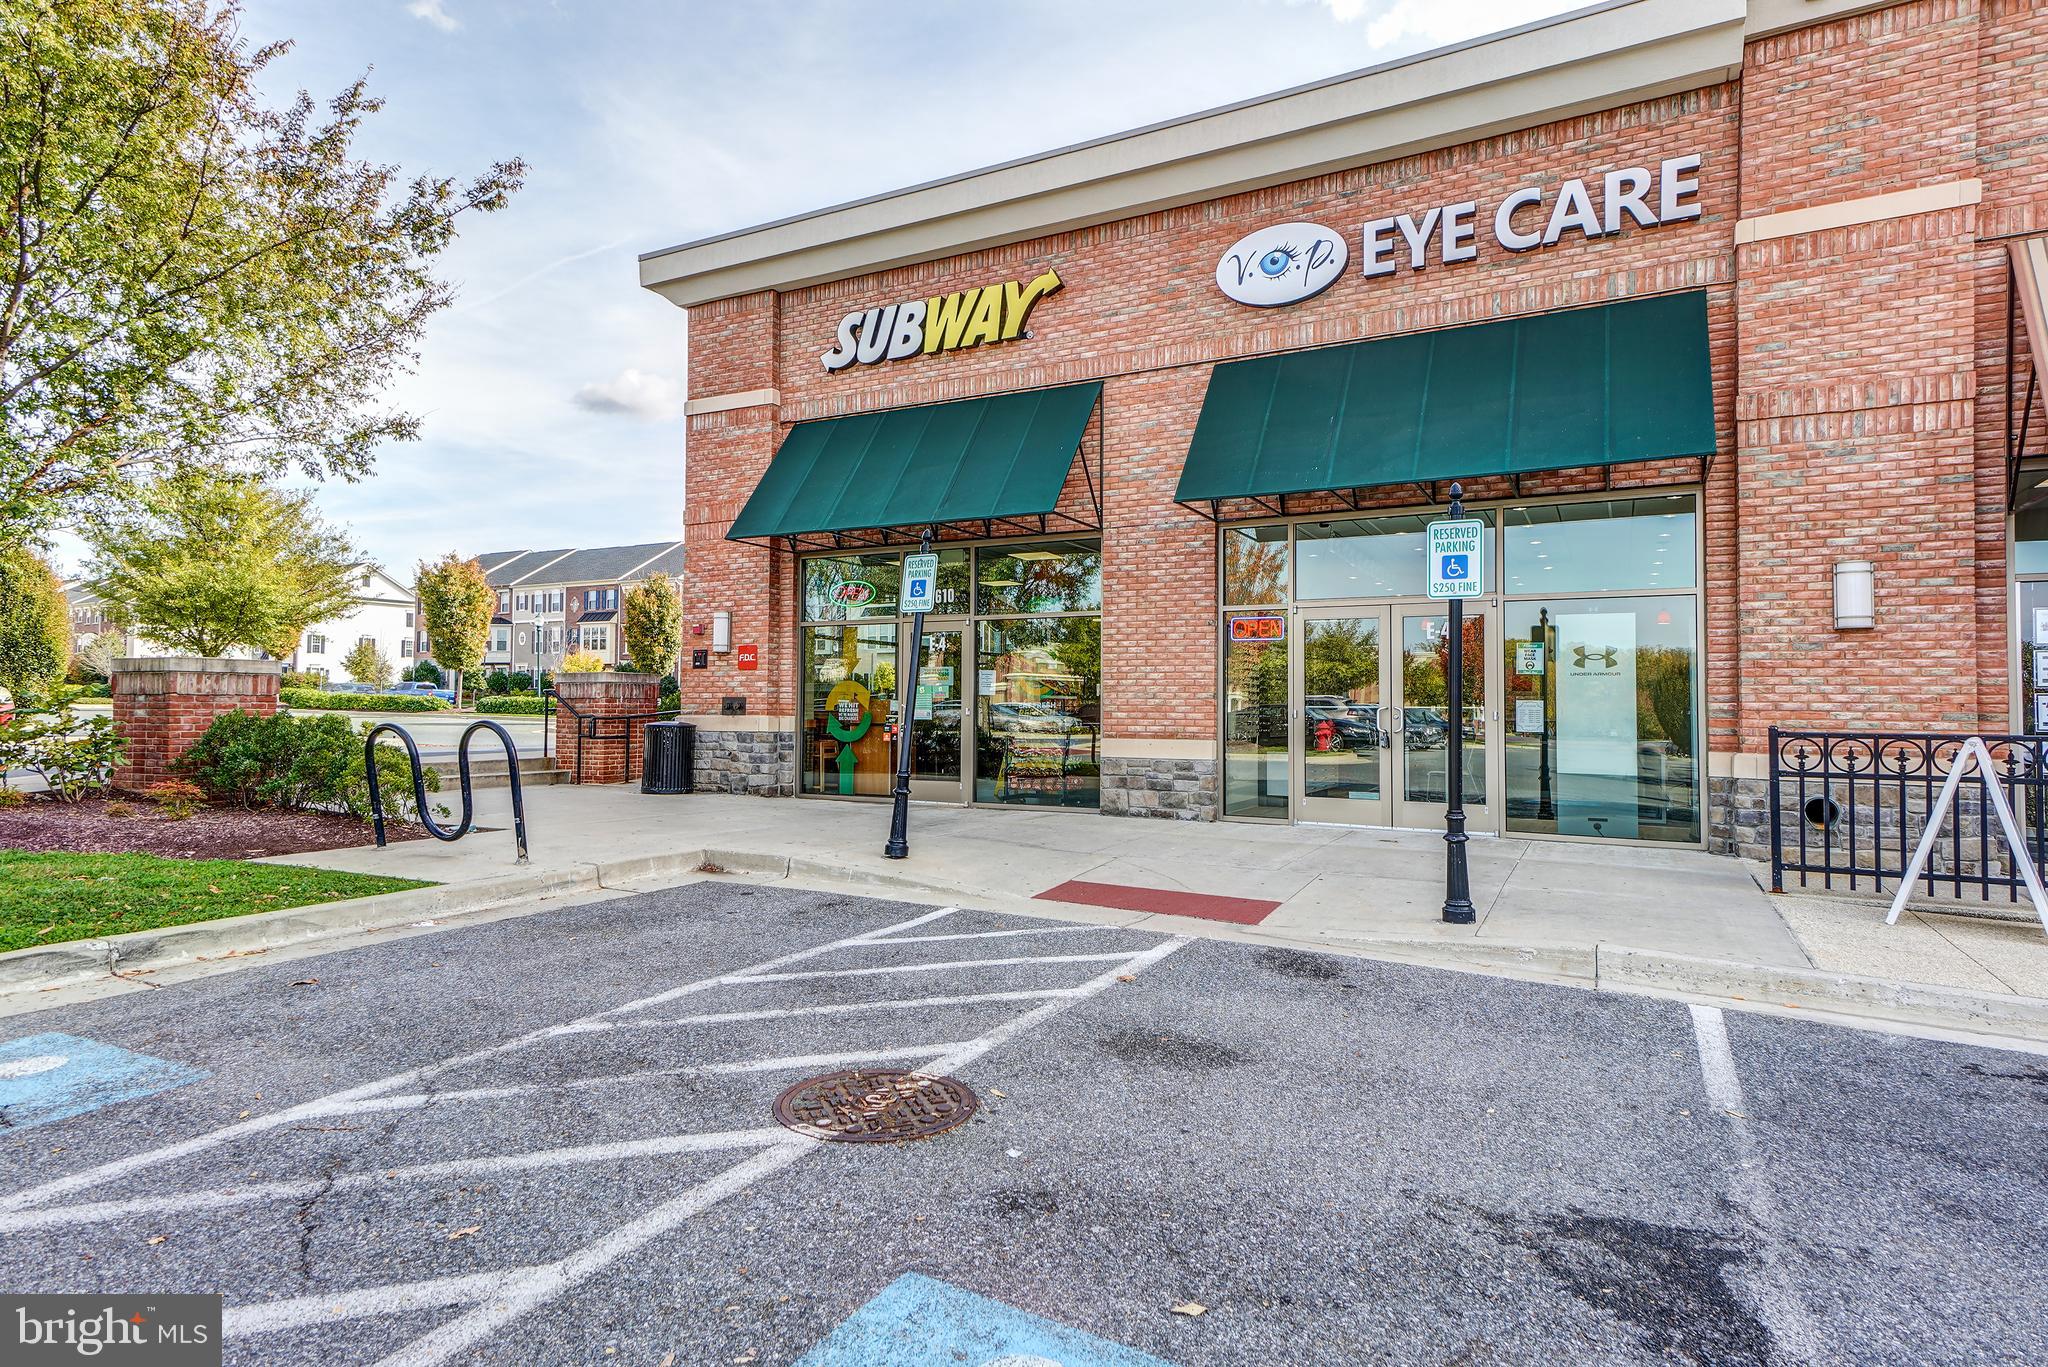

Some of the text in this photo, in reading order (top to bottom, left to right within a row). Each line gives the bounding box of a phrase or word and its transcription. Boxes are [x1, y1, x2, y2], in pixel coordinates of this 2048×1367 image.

[1363, 153, 1702, 279] EYE CARE
[820, 267, 1065, 372] SUBWAY
[1433, 526, 1478, 540] RESERVED
[1435, 540, 1476, 553] PARKING
[907, 559, 935, 569] RESERVED
[907, 568, 932, 578] PARKING
[833, 586, 870, 600] OPEN
[1458, 581, 1478, 592] FINE
[935, 588, 954, 603] 610
[918, 599, 930, 607] FINE
[1234, 620, 1281, 638] OPEN
